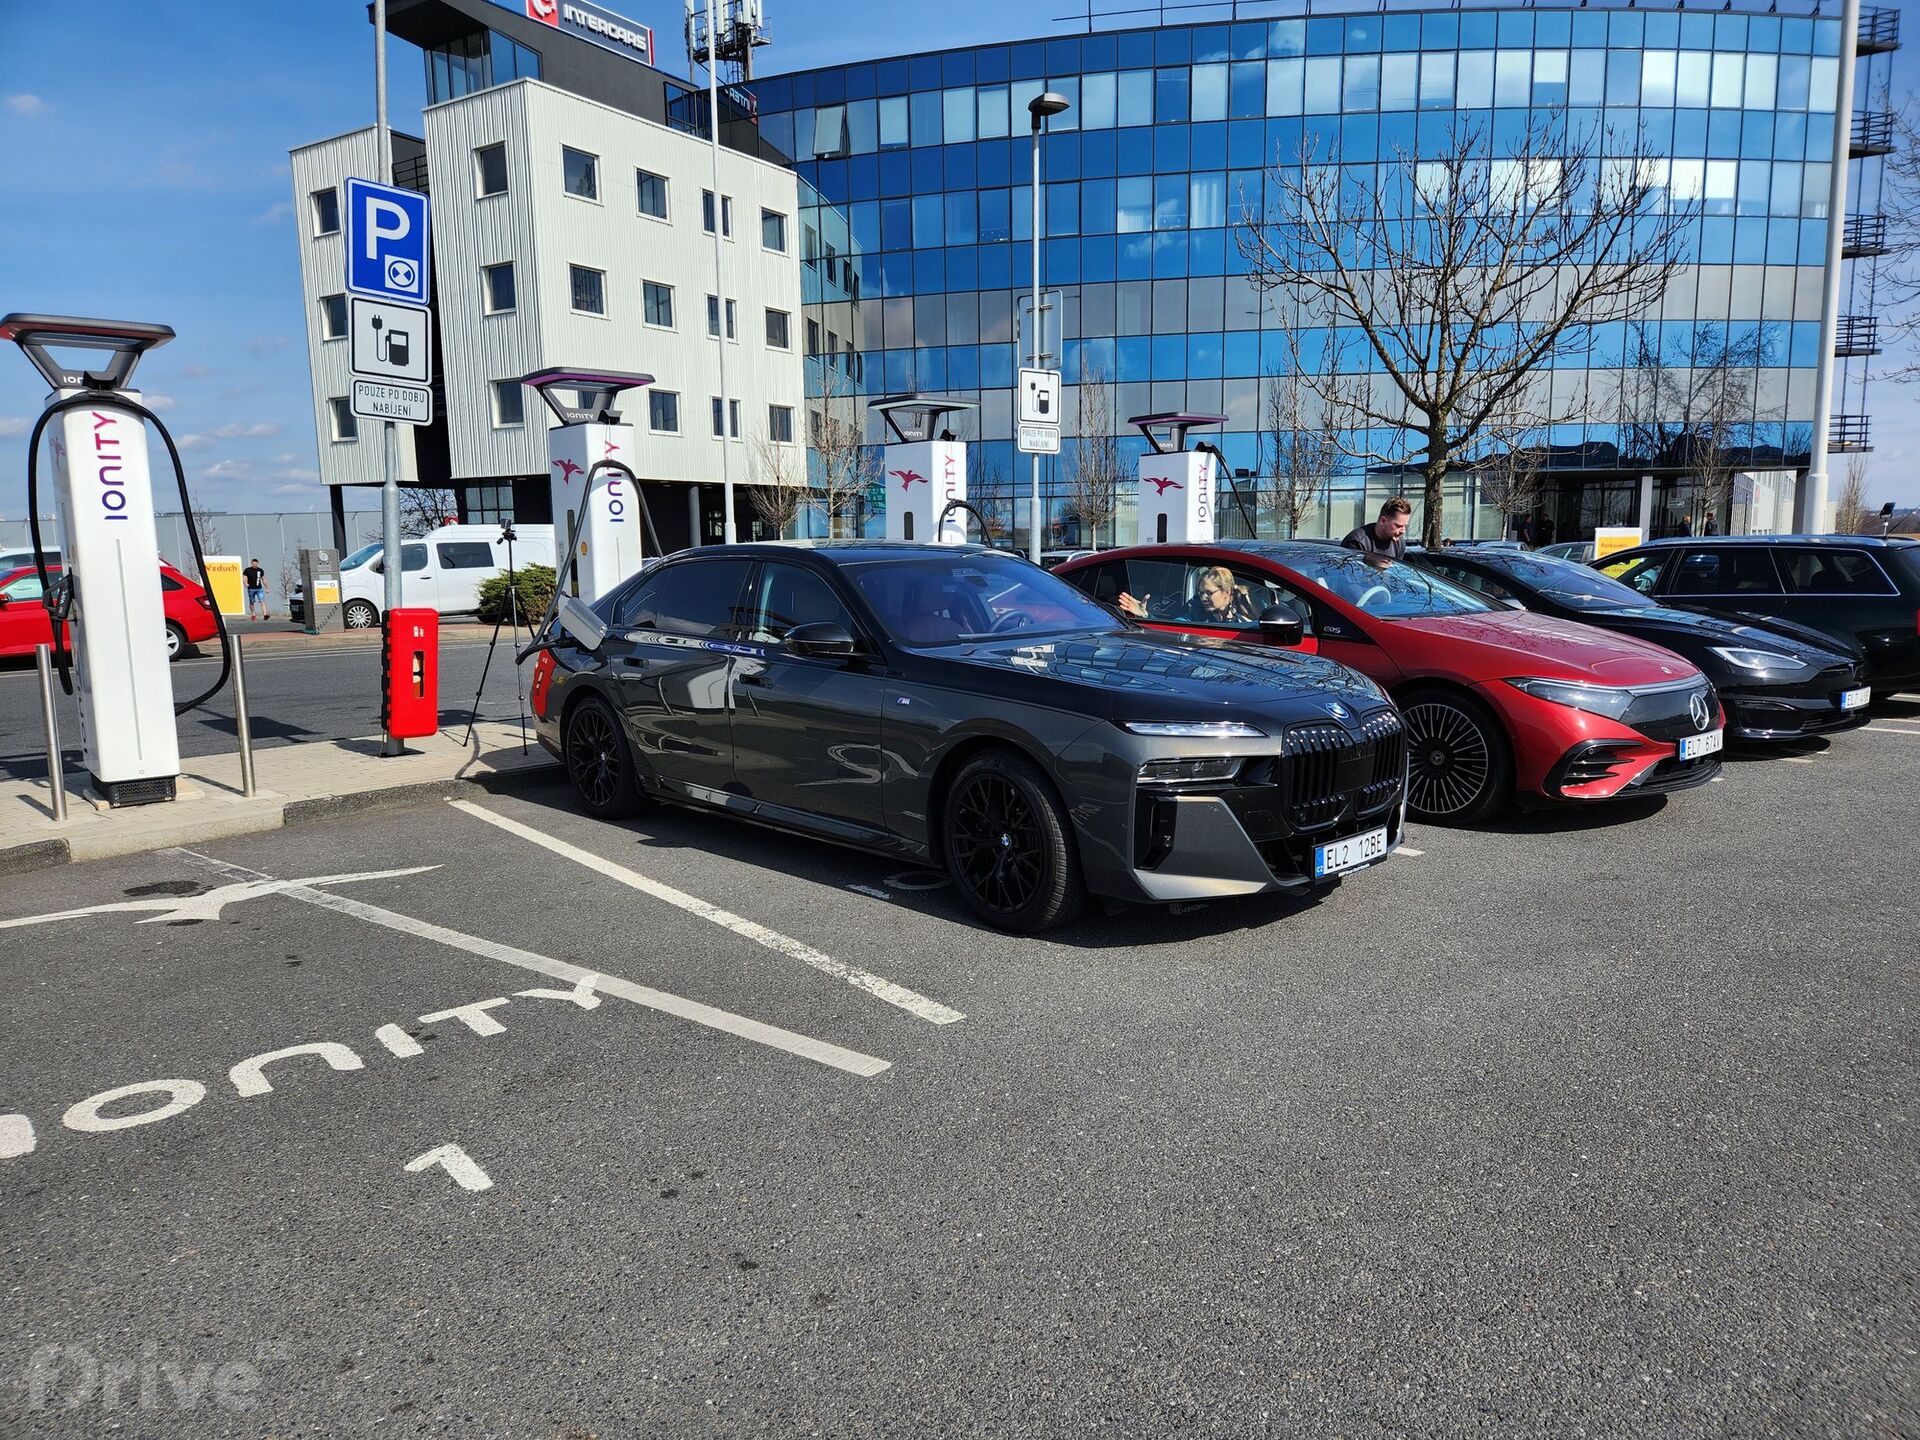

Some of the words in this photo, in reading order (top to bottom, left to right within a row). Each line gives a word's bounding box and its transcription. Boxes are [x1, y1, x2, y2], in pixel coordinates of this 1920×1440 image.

[563, 3, 647, 51] INTERCARS
[366, 196, 410, 260] P
[359, 385, 386, 398] POUZE
[389, 389, 399, 400] PO
[402, 390, 425, 403] DOBU
[372, 401, 412, 416] NABÍJENÍ
[566, 412, 594, 420] IONITY
[92, 411, 129, 520] IONITY
[604, 440, 624, 522] IONIY
[1198, 464, 1207, 523] IONITY
[205, 564, 238, 572] Vzduch
[1688, 739, 1701, 756] EL7
[1317, 865, 1324, 873] CZ
[1327, 844, 1349, 870] EL2
[1359, 833, 1383, 859] 12BE
[404, 1143, 495, 1192] 1
